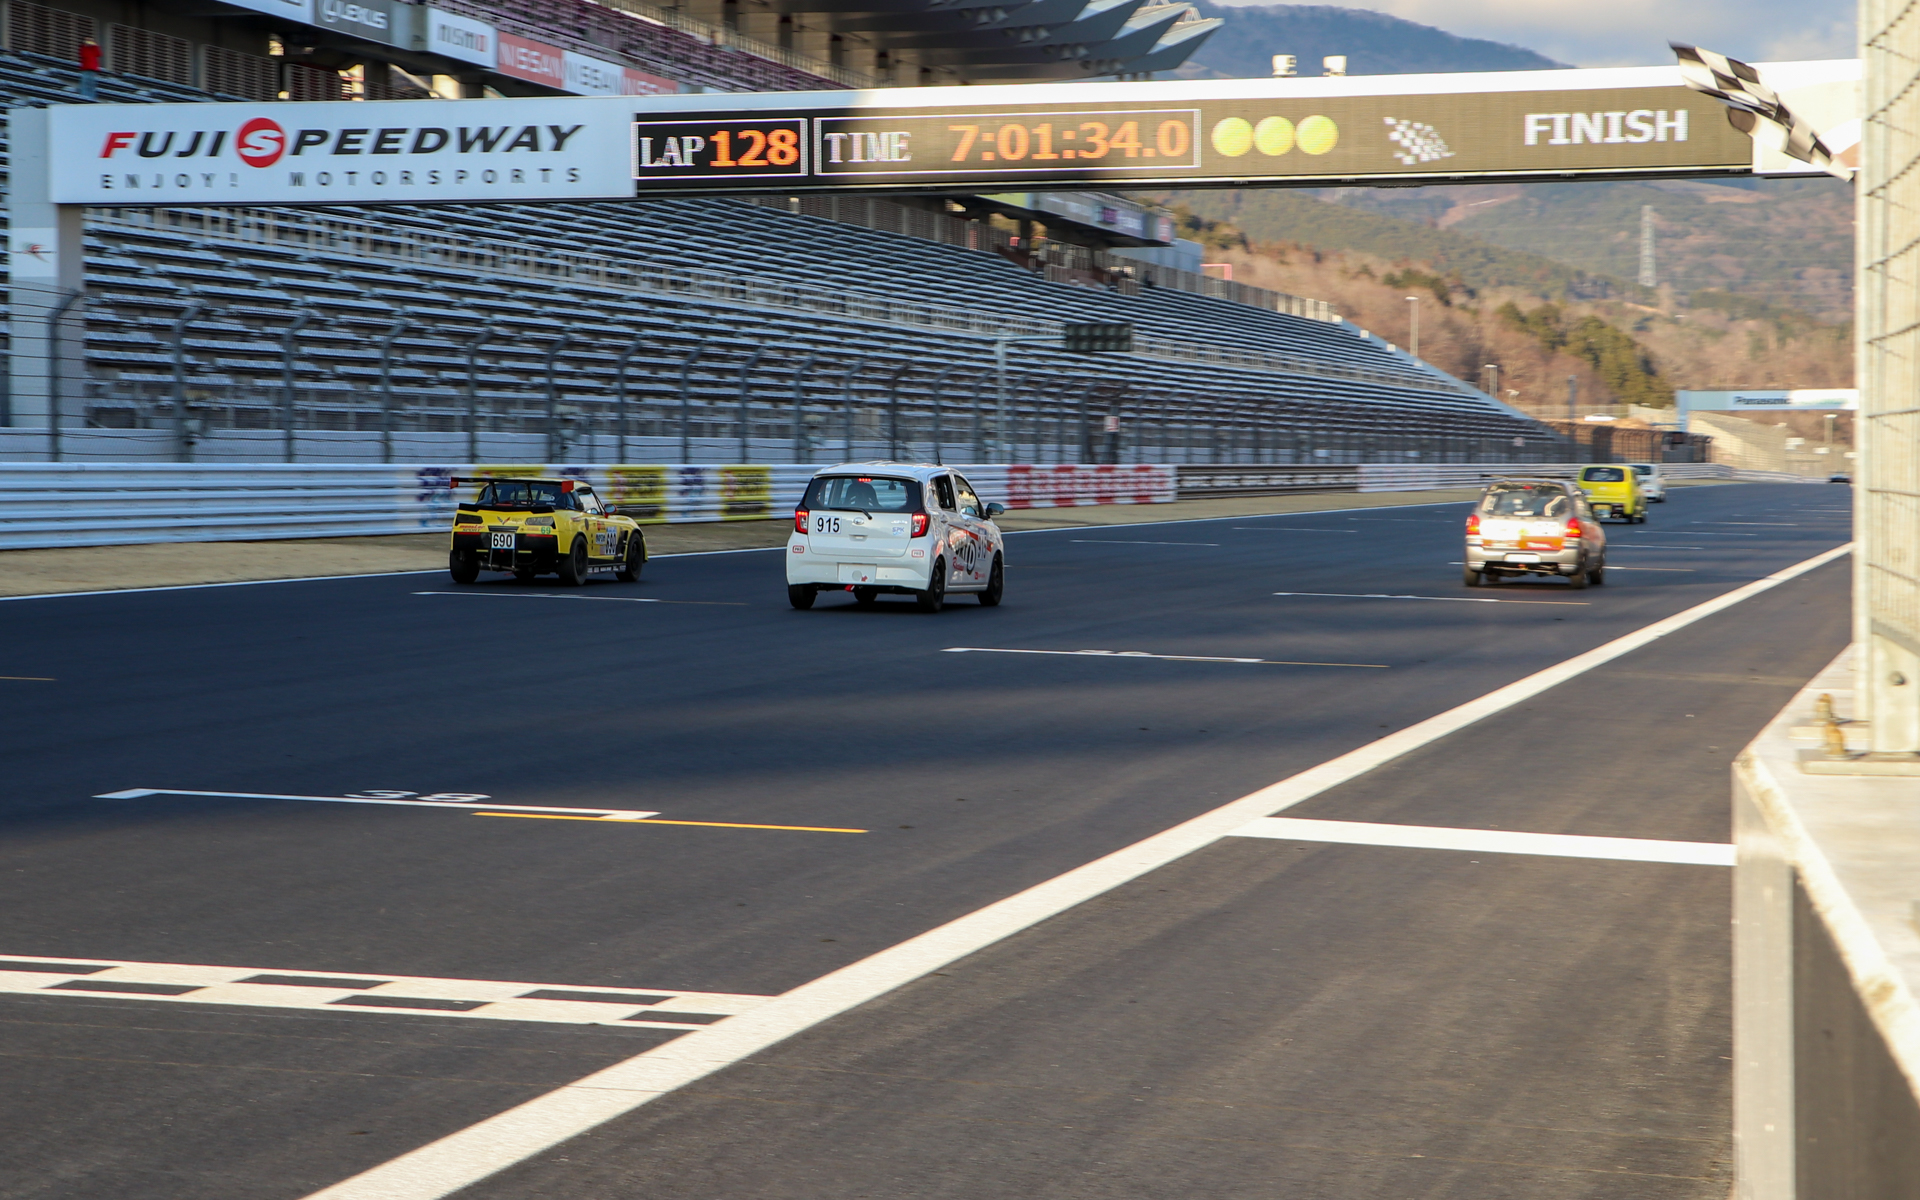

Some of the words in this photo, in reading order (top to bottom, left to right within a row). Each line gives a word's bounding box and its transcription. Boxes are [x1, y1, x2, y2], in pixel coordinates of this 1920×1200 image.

[500, 46, 562, 79] NISSAN
[563, 59, 622, 93] NISSAN
[1524, 109, 1689, 146] FINISH
[99, 131, 229, 158] FUJI
[639, 135, 705, 168] LAP
[709, 129, 799, 168] 128
[824, 131, 911, 163] TIME
[948, 119, 1189, 162] 7:01:34.0
[101, 172, 239, 189] ENJOY!
[289, 167, 582, 187] MOTORSPORTS
[540, 526, 552, 535] 69
[816, 517, 840, 533] 915
[492, 533, 513, 548] 690
[605, 532, 617, 555] 690
